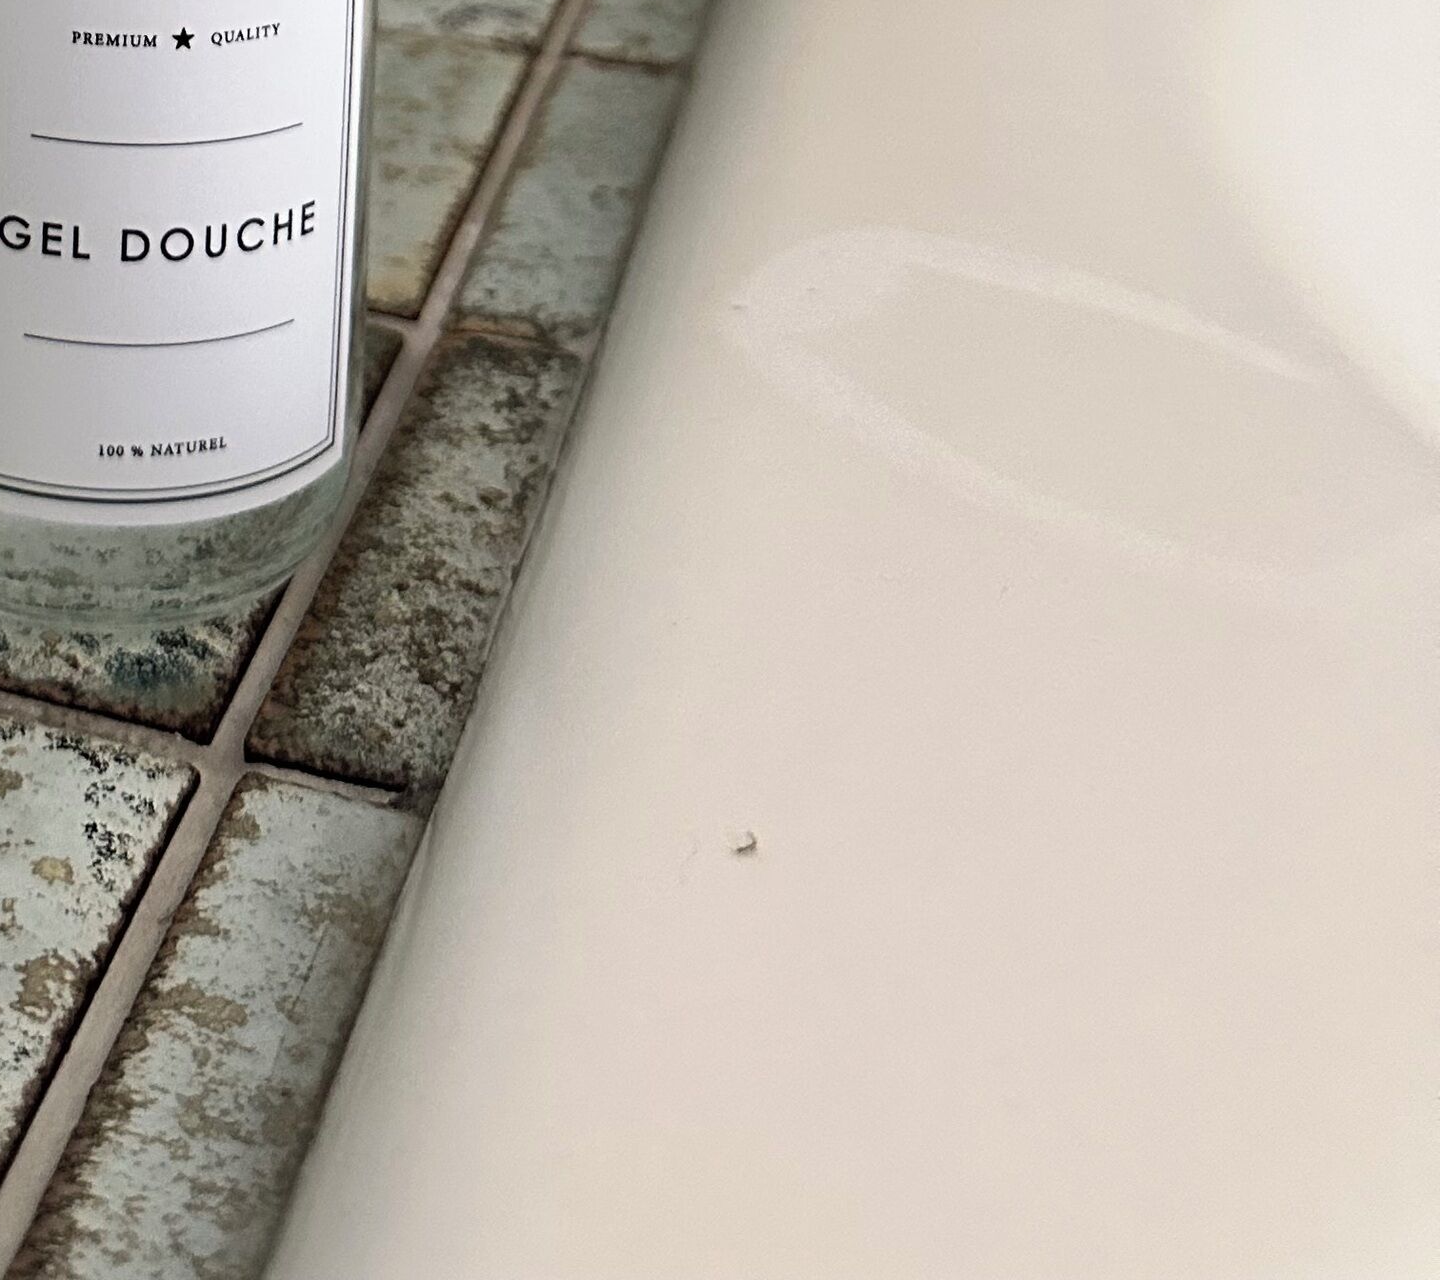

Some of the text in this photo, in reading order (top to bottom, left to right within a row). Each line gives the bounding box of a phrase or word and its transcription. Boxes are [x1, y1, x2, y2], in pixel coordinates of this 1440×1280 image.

[72, 23, 281, 47] PREMIUM QUALITY
[120, 200, 316, 262] DOUCHE
[99, 436, 227, 456] 100 % NATUREL
